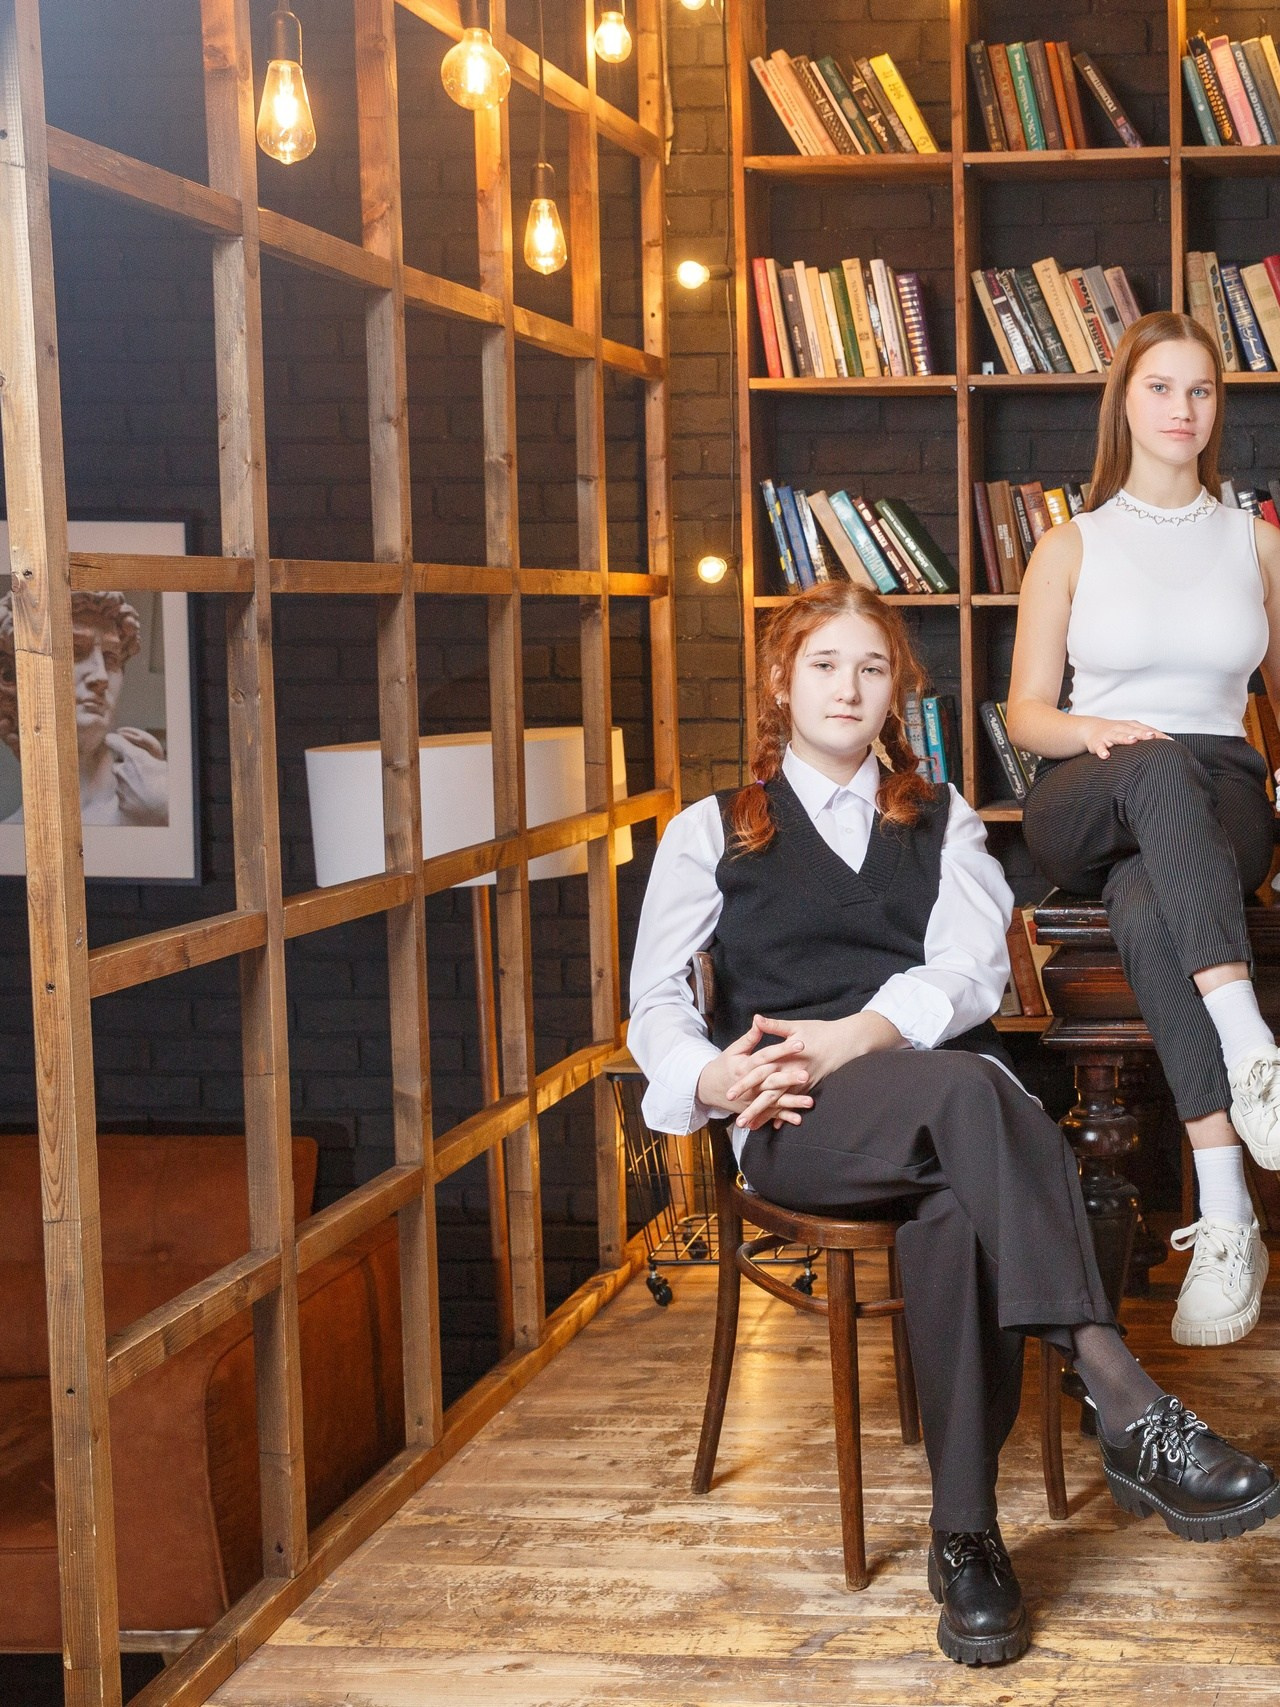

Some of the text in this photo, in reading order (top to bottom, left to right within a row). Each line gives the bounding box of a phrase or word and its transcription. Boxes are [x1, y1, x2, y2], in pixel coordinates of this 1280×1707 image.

[1234, 49, 1244, 62] ОТ
[1238, 61, 1254, 91] ОКЕАНА
[1071, 275, 1096, 317] ДУХОМ
[1086, 316, 1114, 367] СИЛЬНЫЕ
[989, 716, 1005, 745] СИБИРЬ
